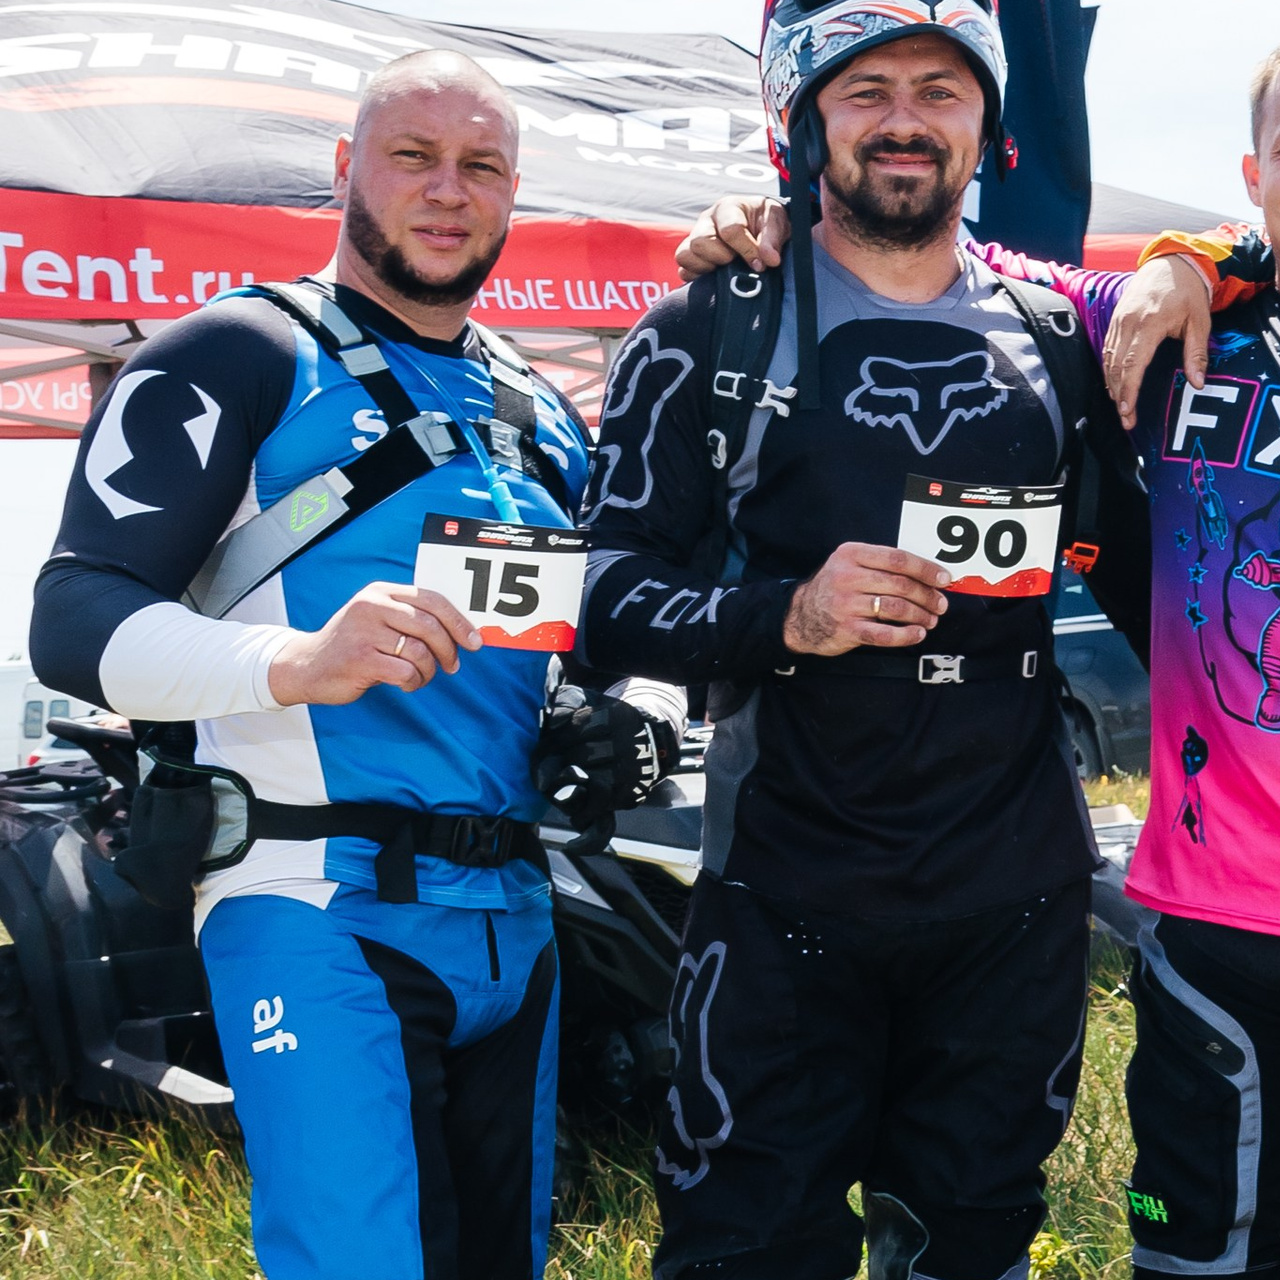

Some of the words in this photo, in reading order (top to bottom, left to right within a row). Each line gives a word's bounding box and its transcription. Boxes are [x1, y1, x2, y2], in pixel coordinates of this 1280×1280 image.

[472, 278, 561, 311] НЫЕ
[935, 515, 1028, 569] 90
[464, 556, 540, 618] 15
[609, 578, 741, 630] FOX
